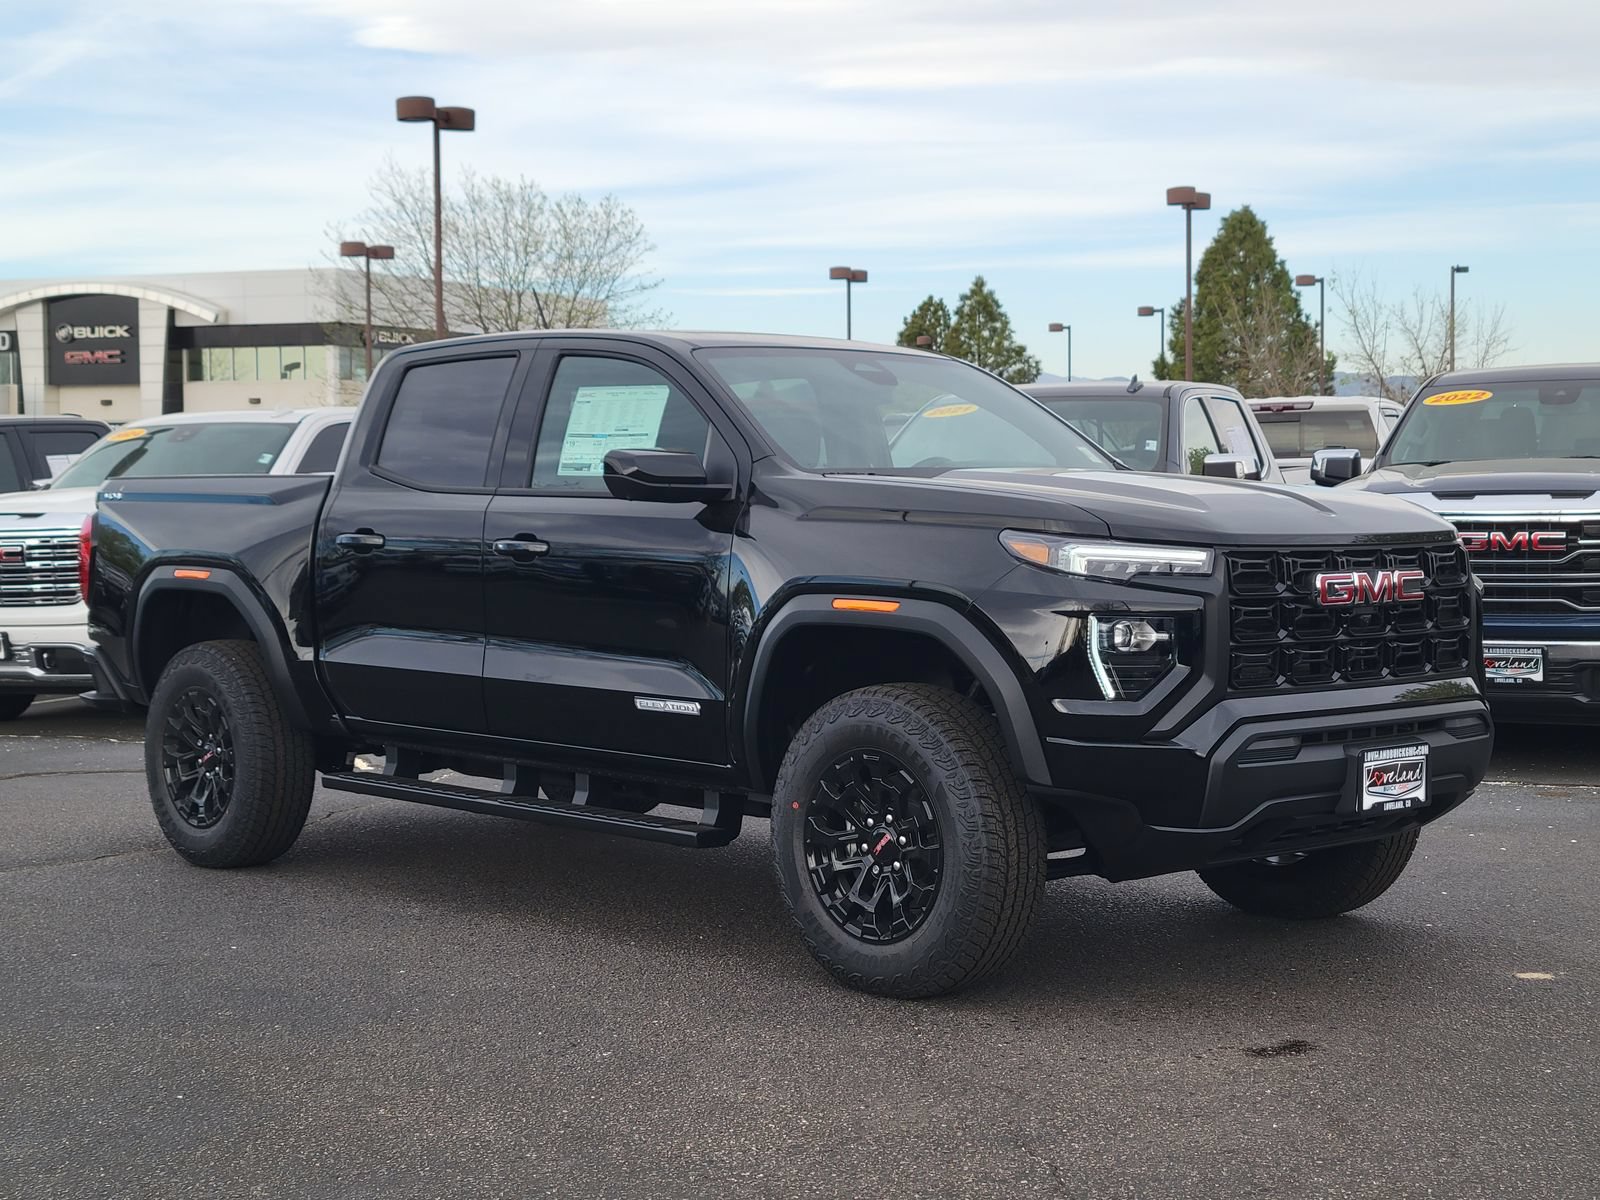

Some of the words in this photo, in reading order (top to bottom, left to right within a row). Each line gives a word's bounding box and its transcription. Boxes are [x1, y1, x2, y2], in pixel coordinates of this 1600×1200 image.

[73, 325, 131, 339] BUICK
[64, 350, 121, 364] GMC
[1429, 391, 1489, 404] 2022
[1459, 531, 1567, 551] GMC
[1315, 570, 1425, 606] GMC
[639, 700, 696, 713] ELEVATION
